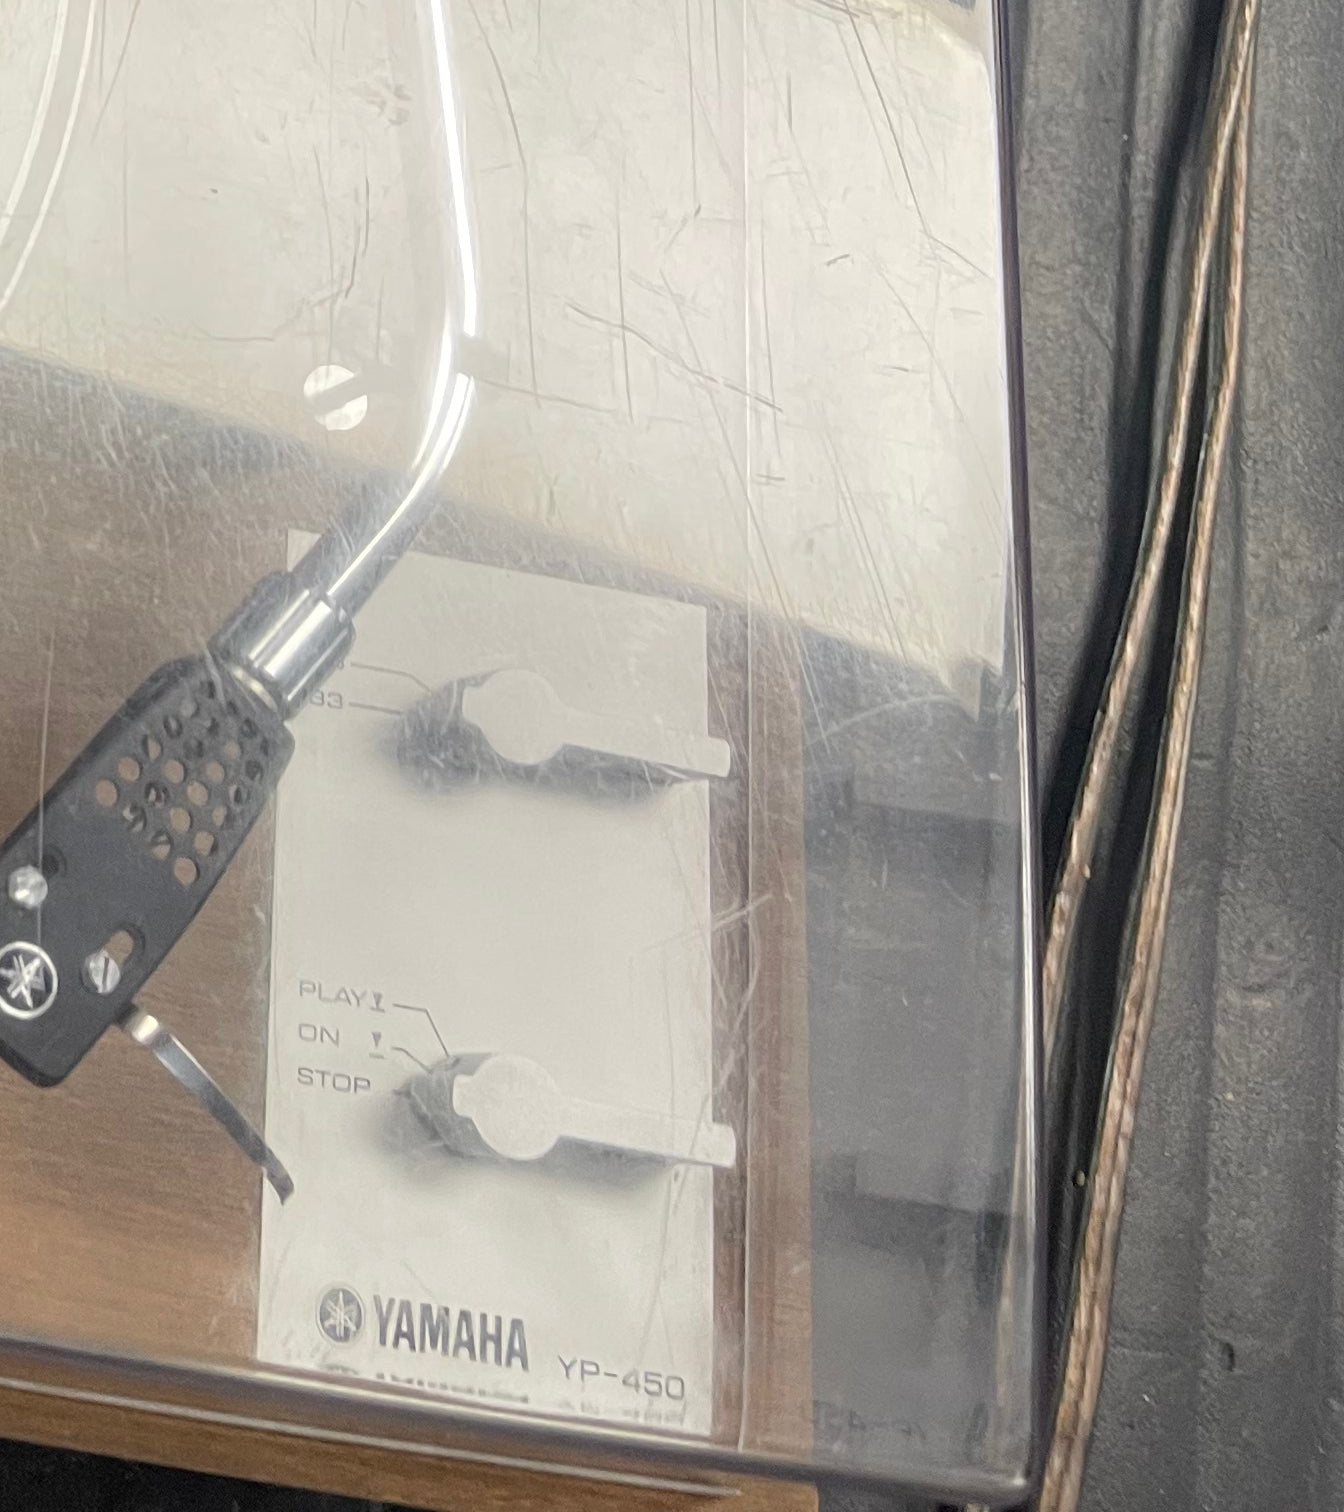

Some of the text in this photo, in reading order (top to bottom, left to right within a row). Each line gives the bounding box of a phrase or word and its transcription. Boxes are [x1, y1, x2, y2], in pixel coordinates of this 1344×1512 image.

[299, 980, 367, 1007] PLAY
[298, 1023, 340, 1047] ON
[297, 1068, 371, 1093] STOP
[372, 1294, 686, 1402] YAMAHA YP-450
